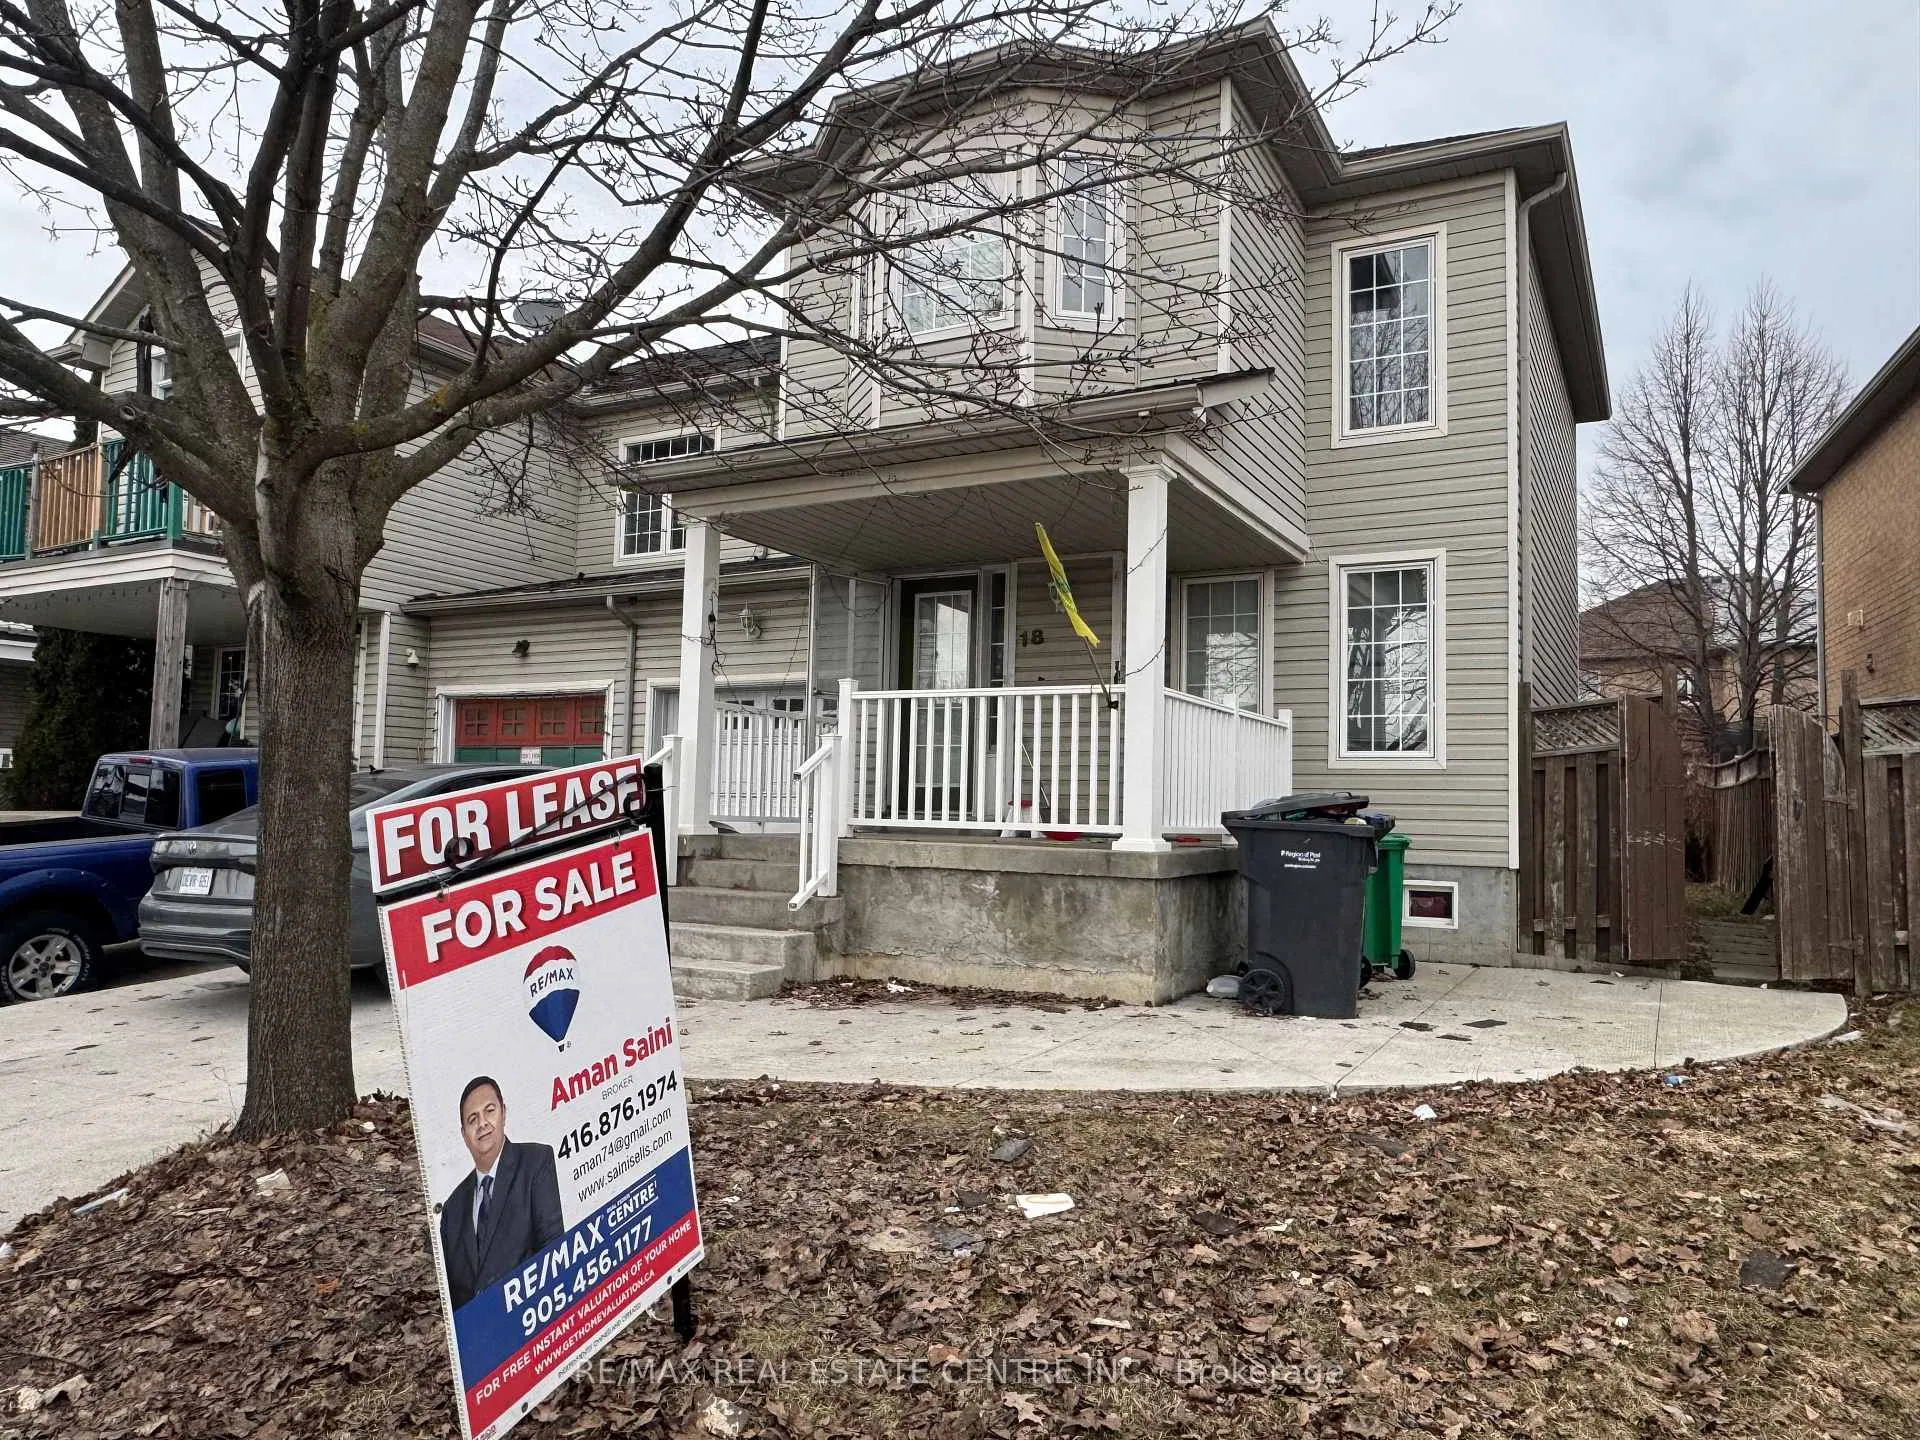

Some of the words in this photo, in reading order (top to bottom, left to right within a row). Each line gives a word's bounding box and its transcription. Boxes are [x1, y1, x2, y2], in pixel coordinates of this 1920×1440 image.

[1019, 629, 1045, 647] 18
[382, 799, 492, 876] FOR
[505, 765, 640, 844] LEASE
[421, 889, 527, 963] FOR
[534, 851, 637, 921] SALE
[529, 967, 574, 998] RE/MAX
[550, 1054, 619, 1111] Aman
[622, 1016, 673, 1068] Saini
[601, 1075, 634, 1100] BROKER
[557, 1070, 678, 1160] 416.876.1974
[572, 1106, 672, 1181] aman74@gmail.com
[578, 1130, 673, 1203] www.sainisells.com
[607, 1182, 655, 1228] CENTRE
[503, 1215, 605, 1313] RE/MAX
[521, 1215, 652, 1337] 905.456.1177
[475, 1378, 501, 1405] FOR
[502, 1351, 532, 1383] FREE
[532, 1313, 576, 1357] INSTANT
[577, 1269, 630, 1320] VALUATION
[630, 1259, 643, 1277] OF
[644, 1239, 668, 1265] YOUR
[668, 1219, 692, 1246] HOME
[534, 1269, 656, 1375] WWW.GETHOMEVALUATION.CA
